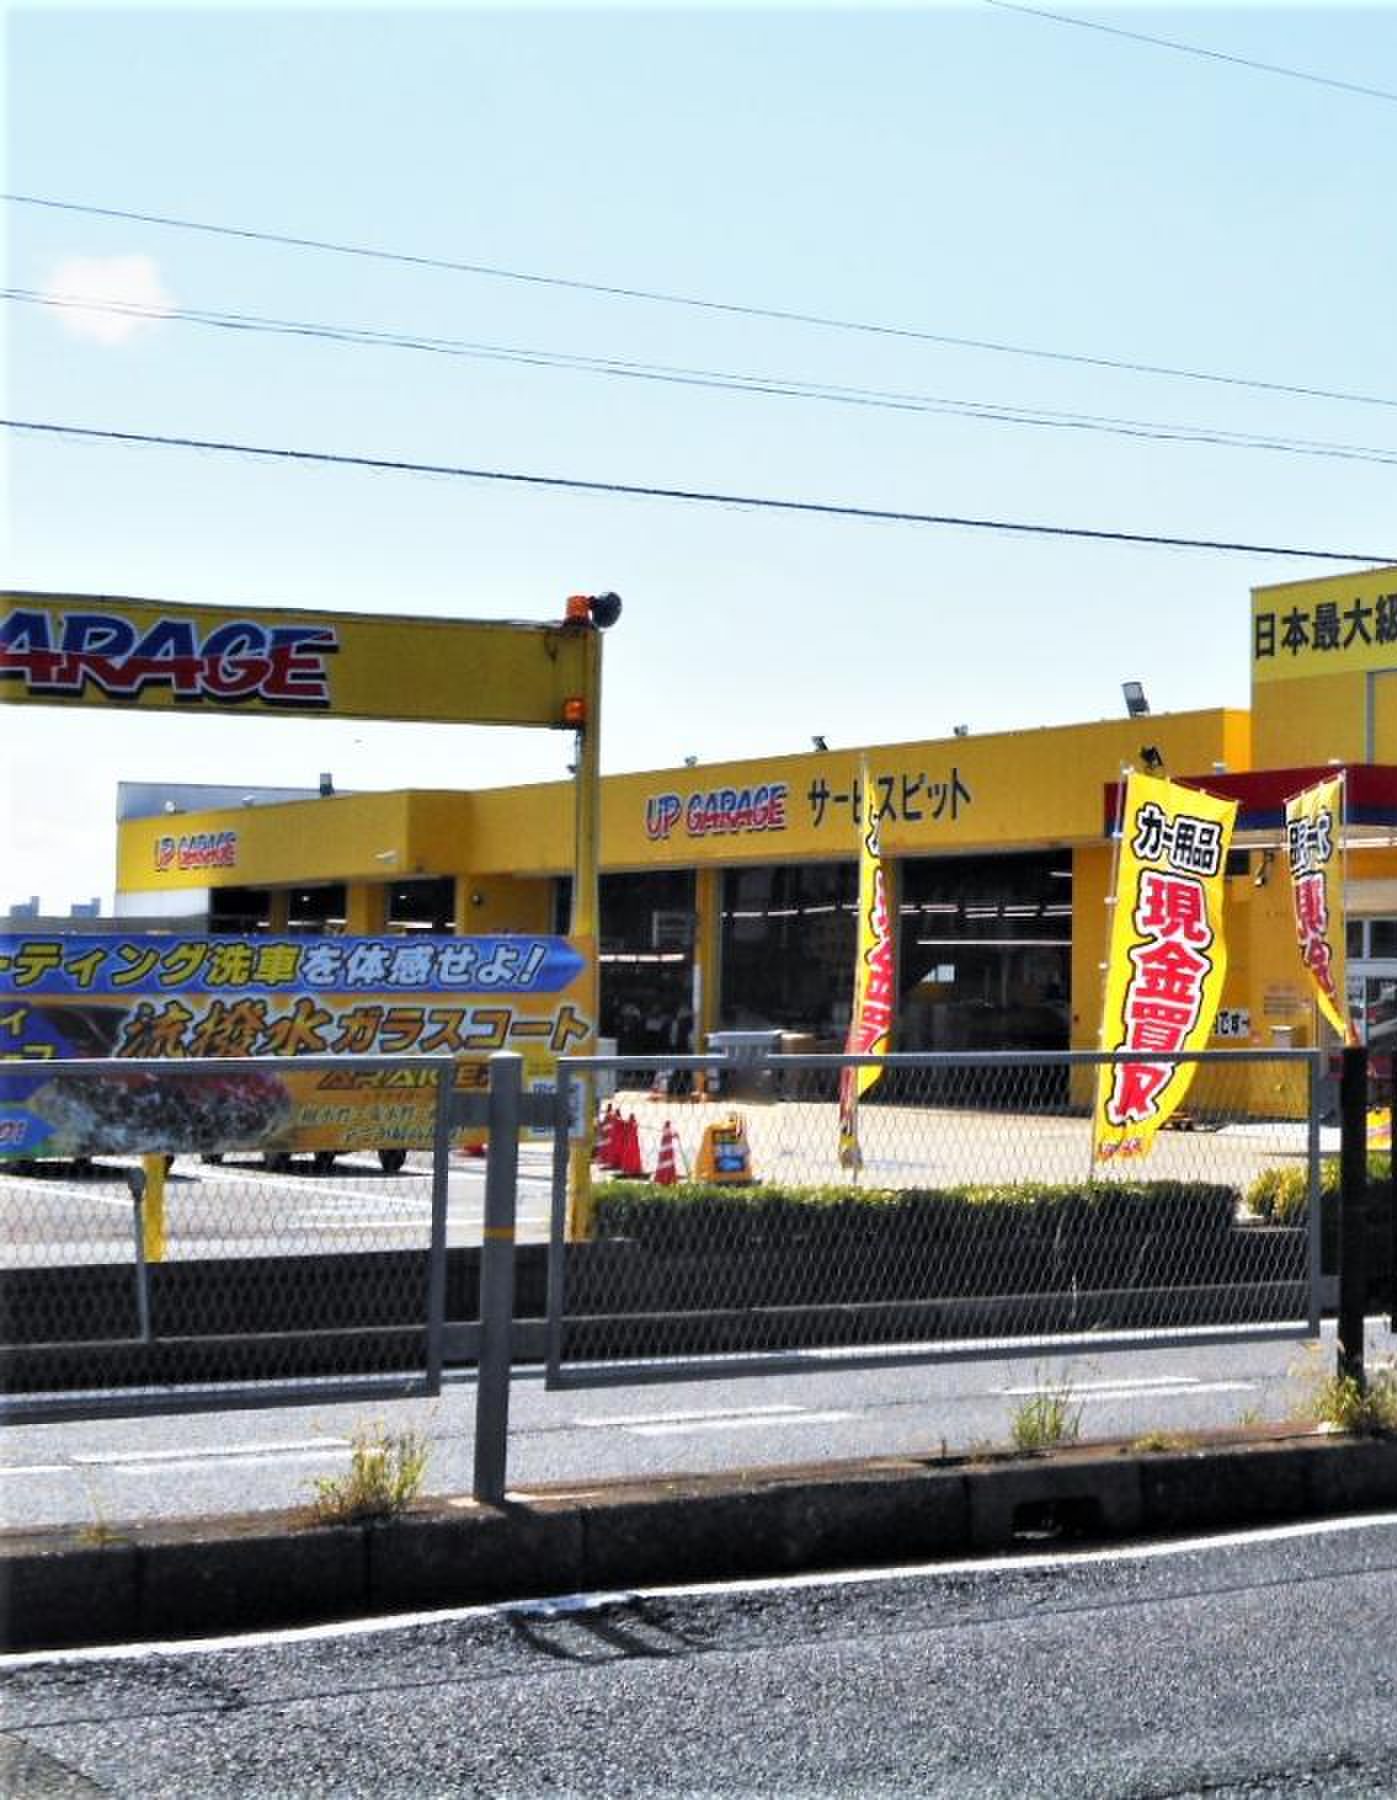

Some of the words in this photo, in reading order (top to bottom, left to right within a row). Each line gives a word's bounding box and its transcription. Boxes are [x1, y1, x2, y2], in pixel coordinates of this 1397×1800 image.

[646, 796, 682, 839] UP
[686, 784, 788, 838] GARAGE
[1134, 806, 1222, 873] カー用品
[0, 942, 544, 989] ティング洗車を体感せよ!
